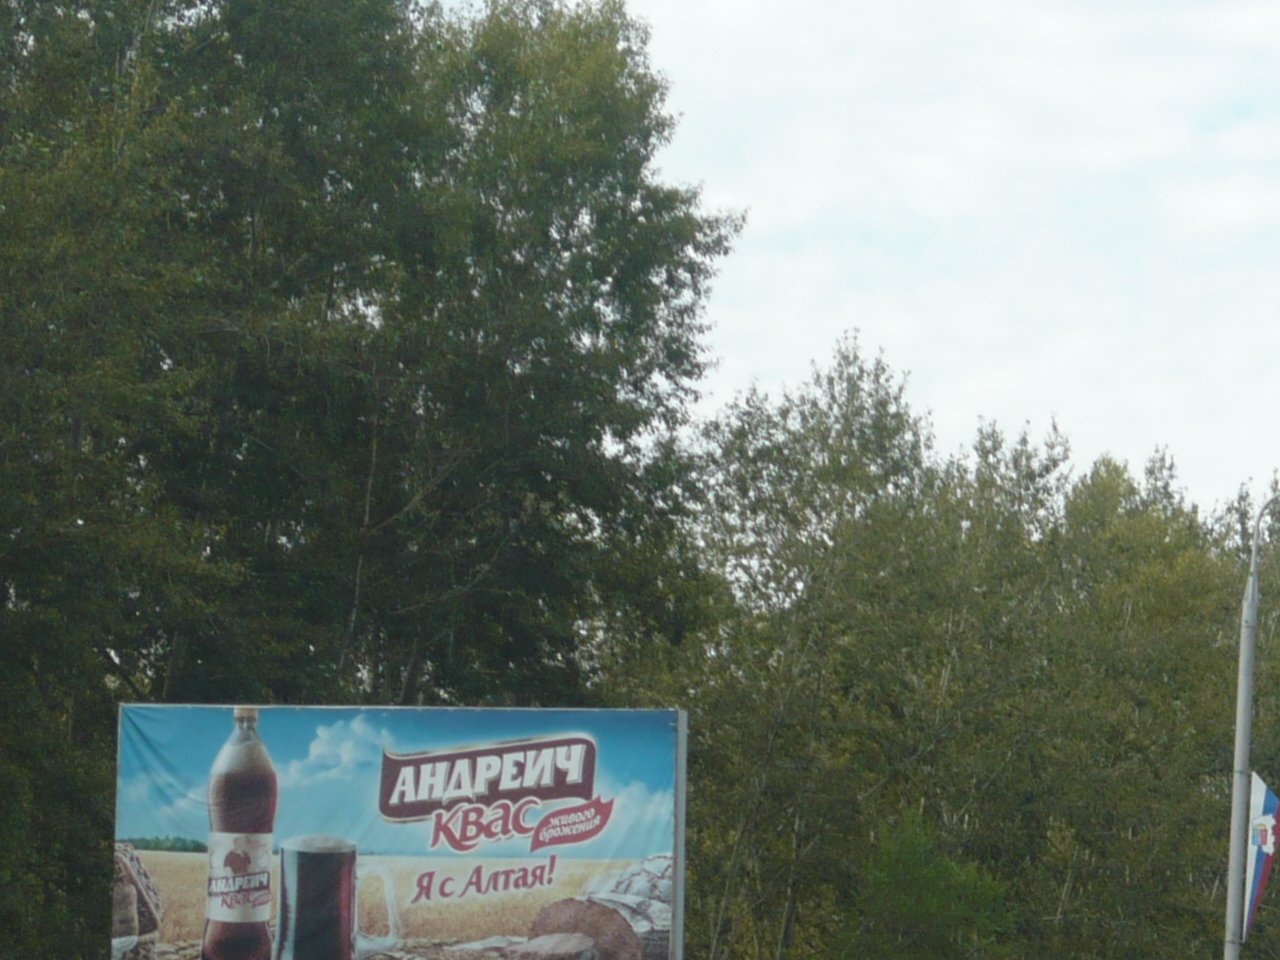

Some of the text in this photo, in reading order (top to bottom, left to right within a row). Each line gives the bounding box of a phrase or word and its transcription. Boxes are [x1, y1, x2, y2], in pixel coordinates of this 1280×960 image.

[389, 743, 587, 805] АНДРЕИЧ
[411, 855, 557, 904] Я с Алтая!
